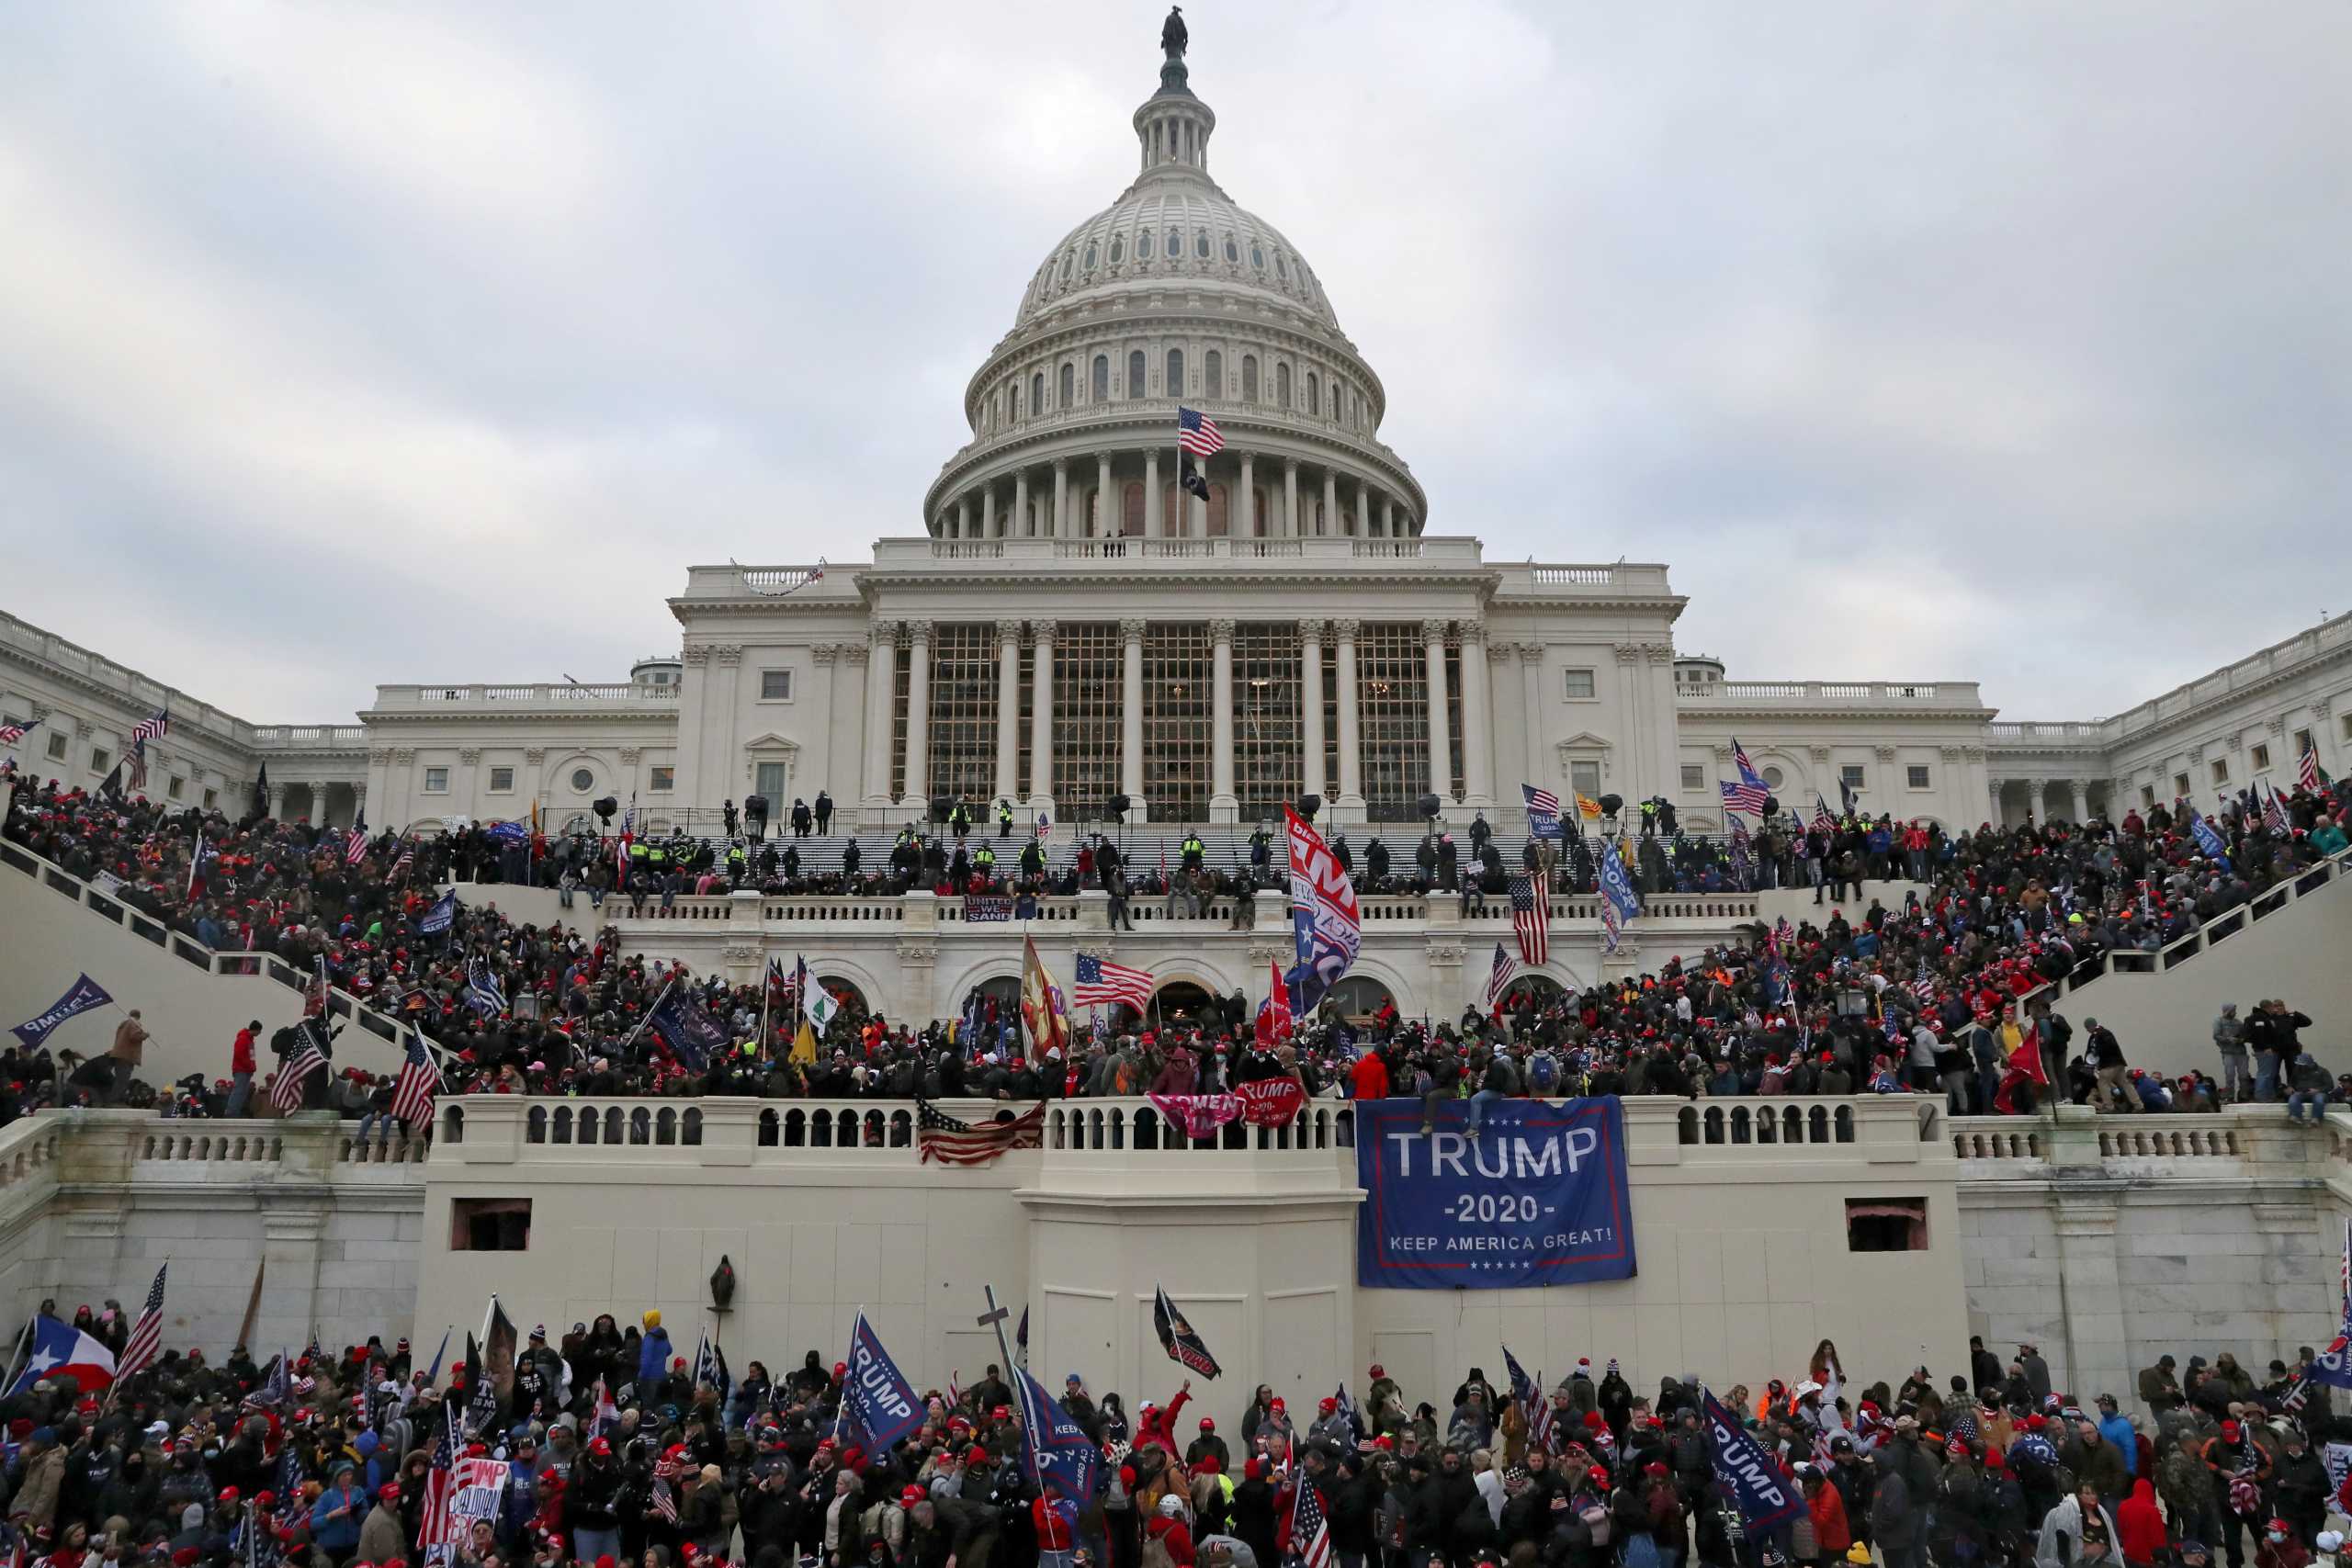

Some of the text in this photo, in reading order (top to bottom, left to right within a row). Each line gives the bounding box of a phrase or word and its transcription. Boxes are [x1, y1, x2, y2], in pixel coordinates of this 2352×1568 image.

[980, 905, 1001, 913] WE
[1387, 1127, 1597, 1179] TRUMP
[1391, 1227, 1612, 1251] KEEP AMERICA GREAT!
